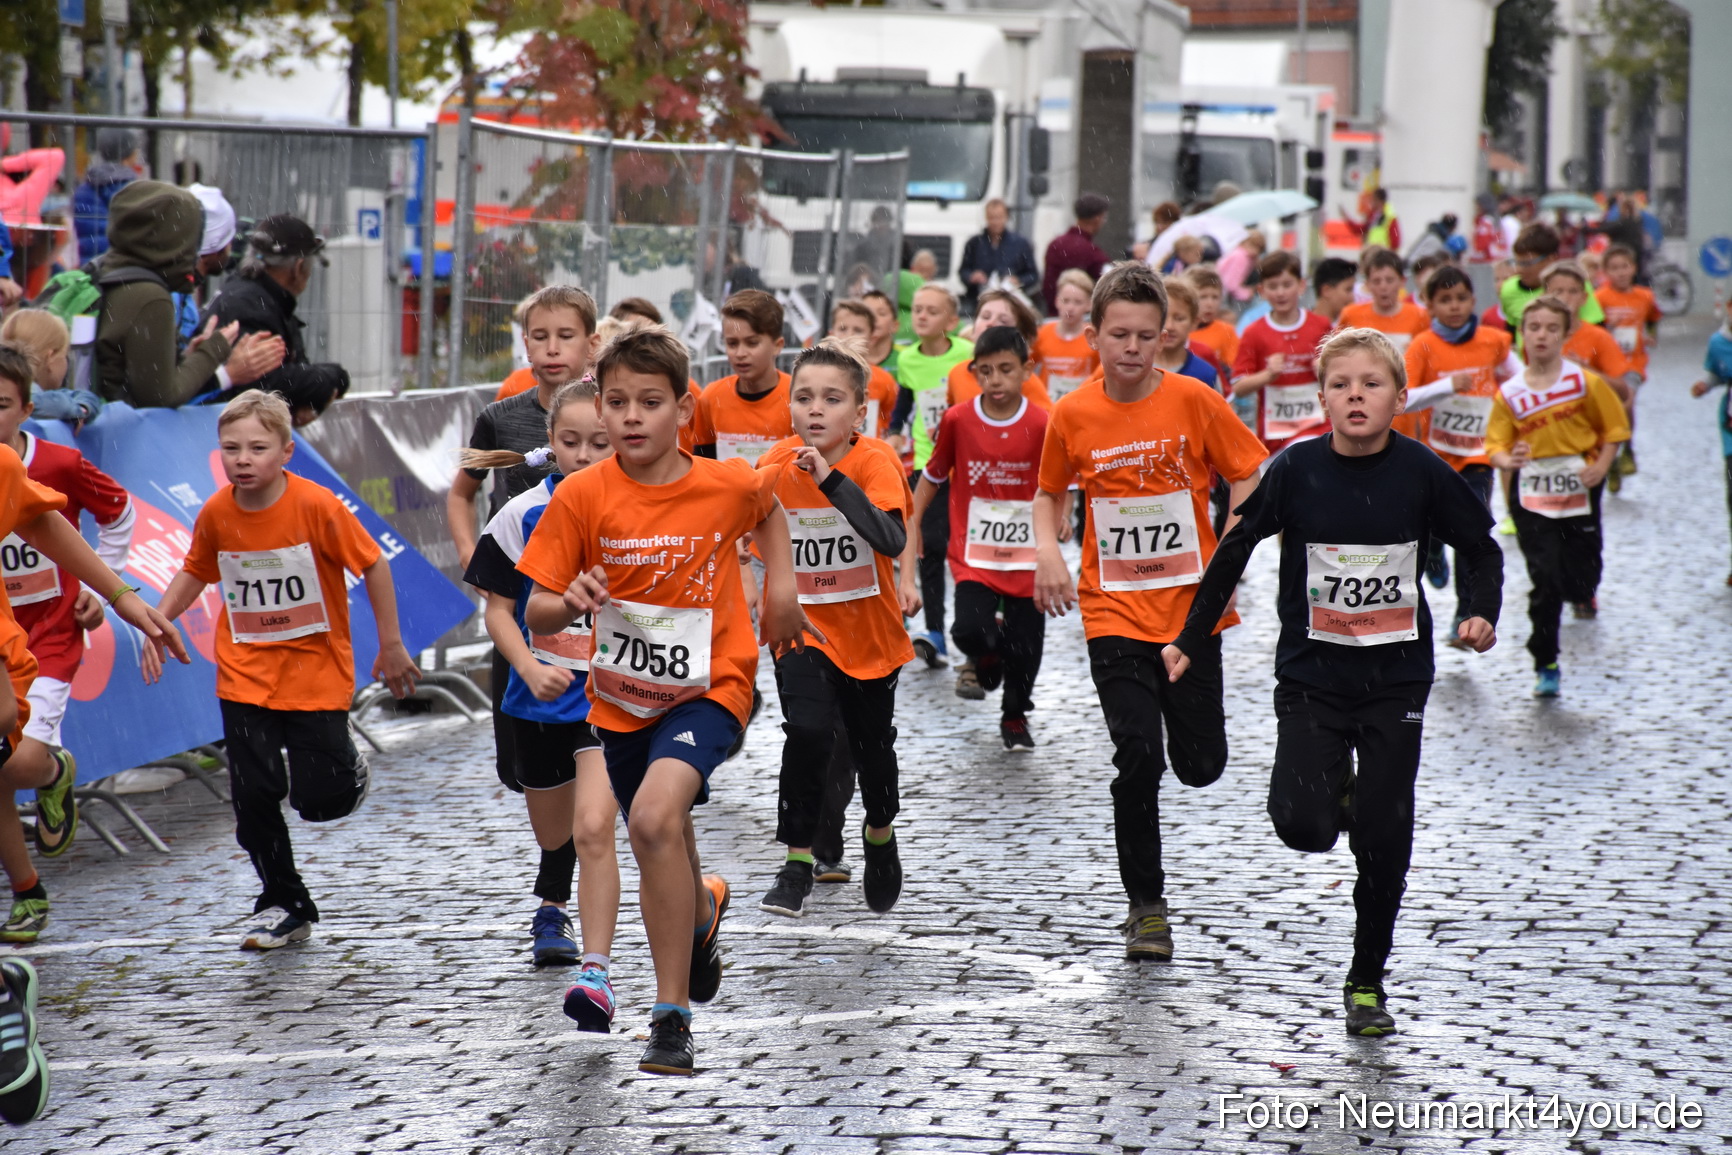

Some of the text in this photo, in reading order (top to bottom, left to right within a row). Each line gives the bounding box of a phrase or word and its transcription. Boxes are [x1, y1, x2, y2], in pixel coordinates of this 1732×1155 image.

[1274, 401, 1314, 419] 7079
[1091, 440, 1157, 459] Neumarkter
[1094, 454, 1145, 473] Stadtlauf
[1530, 473, 1579, 493] 7196
[1129, 504, 1165, 515] BOCK
[806, 516, 837, 525] BOCK
[980, 520, 1029, 543] 7023
[1109, 522, 1182, 554] 7172
[599, 535, 685, 549] Neumarkter
[791, 535, 857, 567] 7076
[602, 550, 668, 566] Stadtlauf
[1349, 555, 1388, 564] BOCK
[1134, 563, 1165, 574] Jonas
[815, 575, 837, 587] Paul
[235, 575, 305, 607] 7170
[1324, 575, 1402, 608] 7323
[260, 615, 291, 626] Lukas
[633, 614, 675, 628] BOCK
[1324, 613, 1376, 628] Johannes
[612, 631, 690, 680] 7058
[619, 681, 675, 702] Johannes
